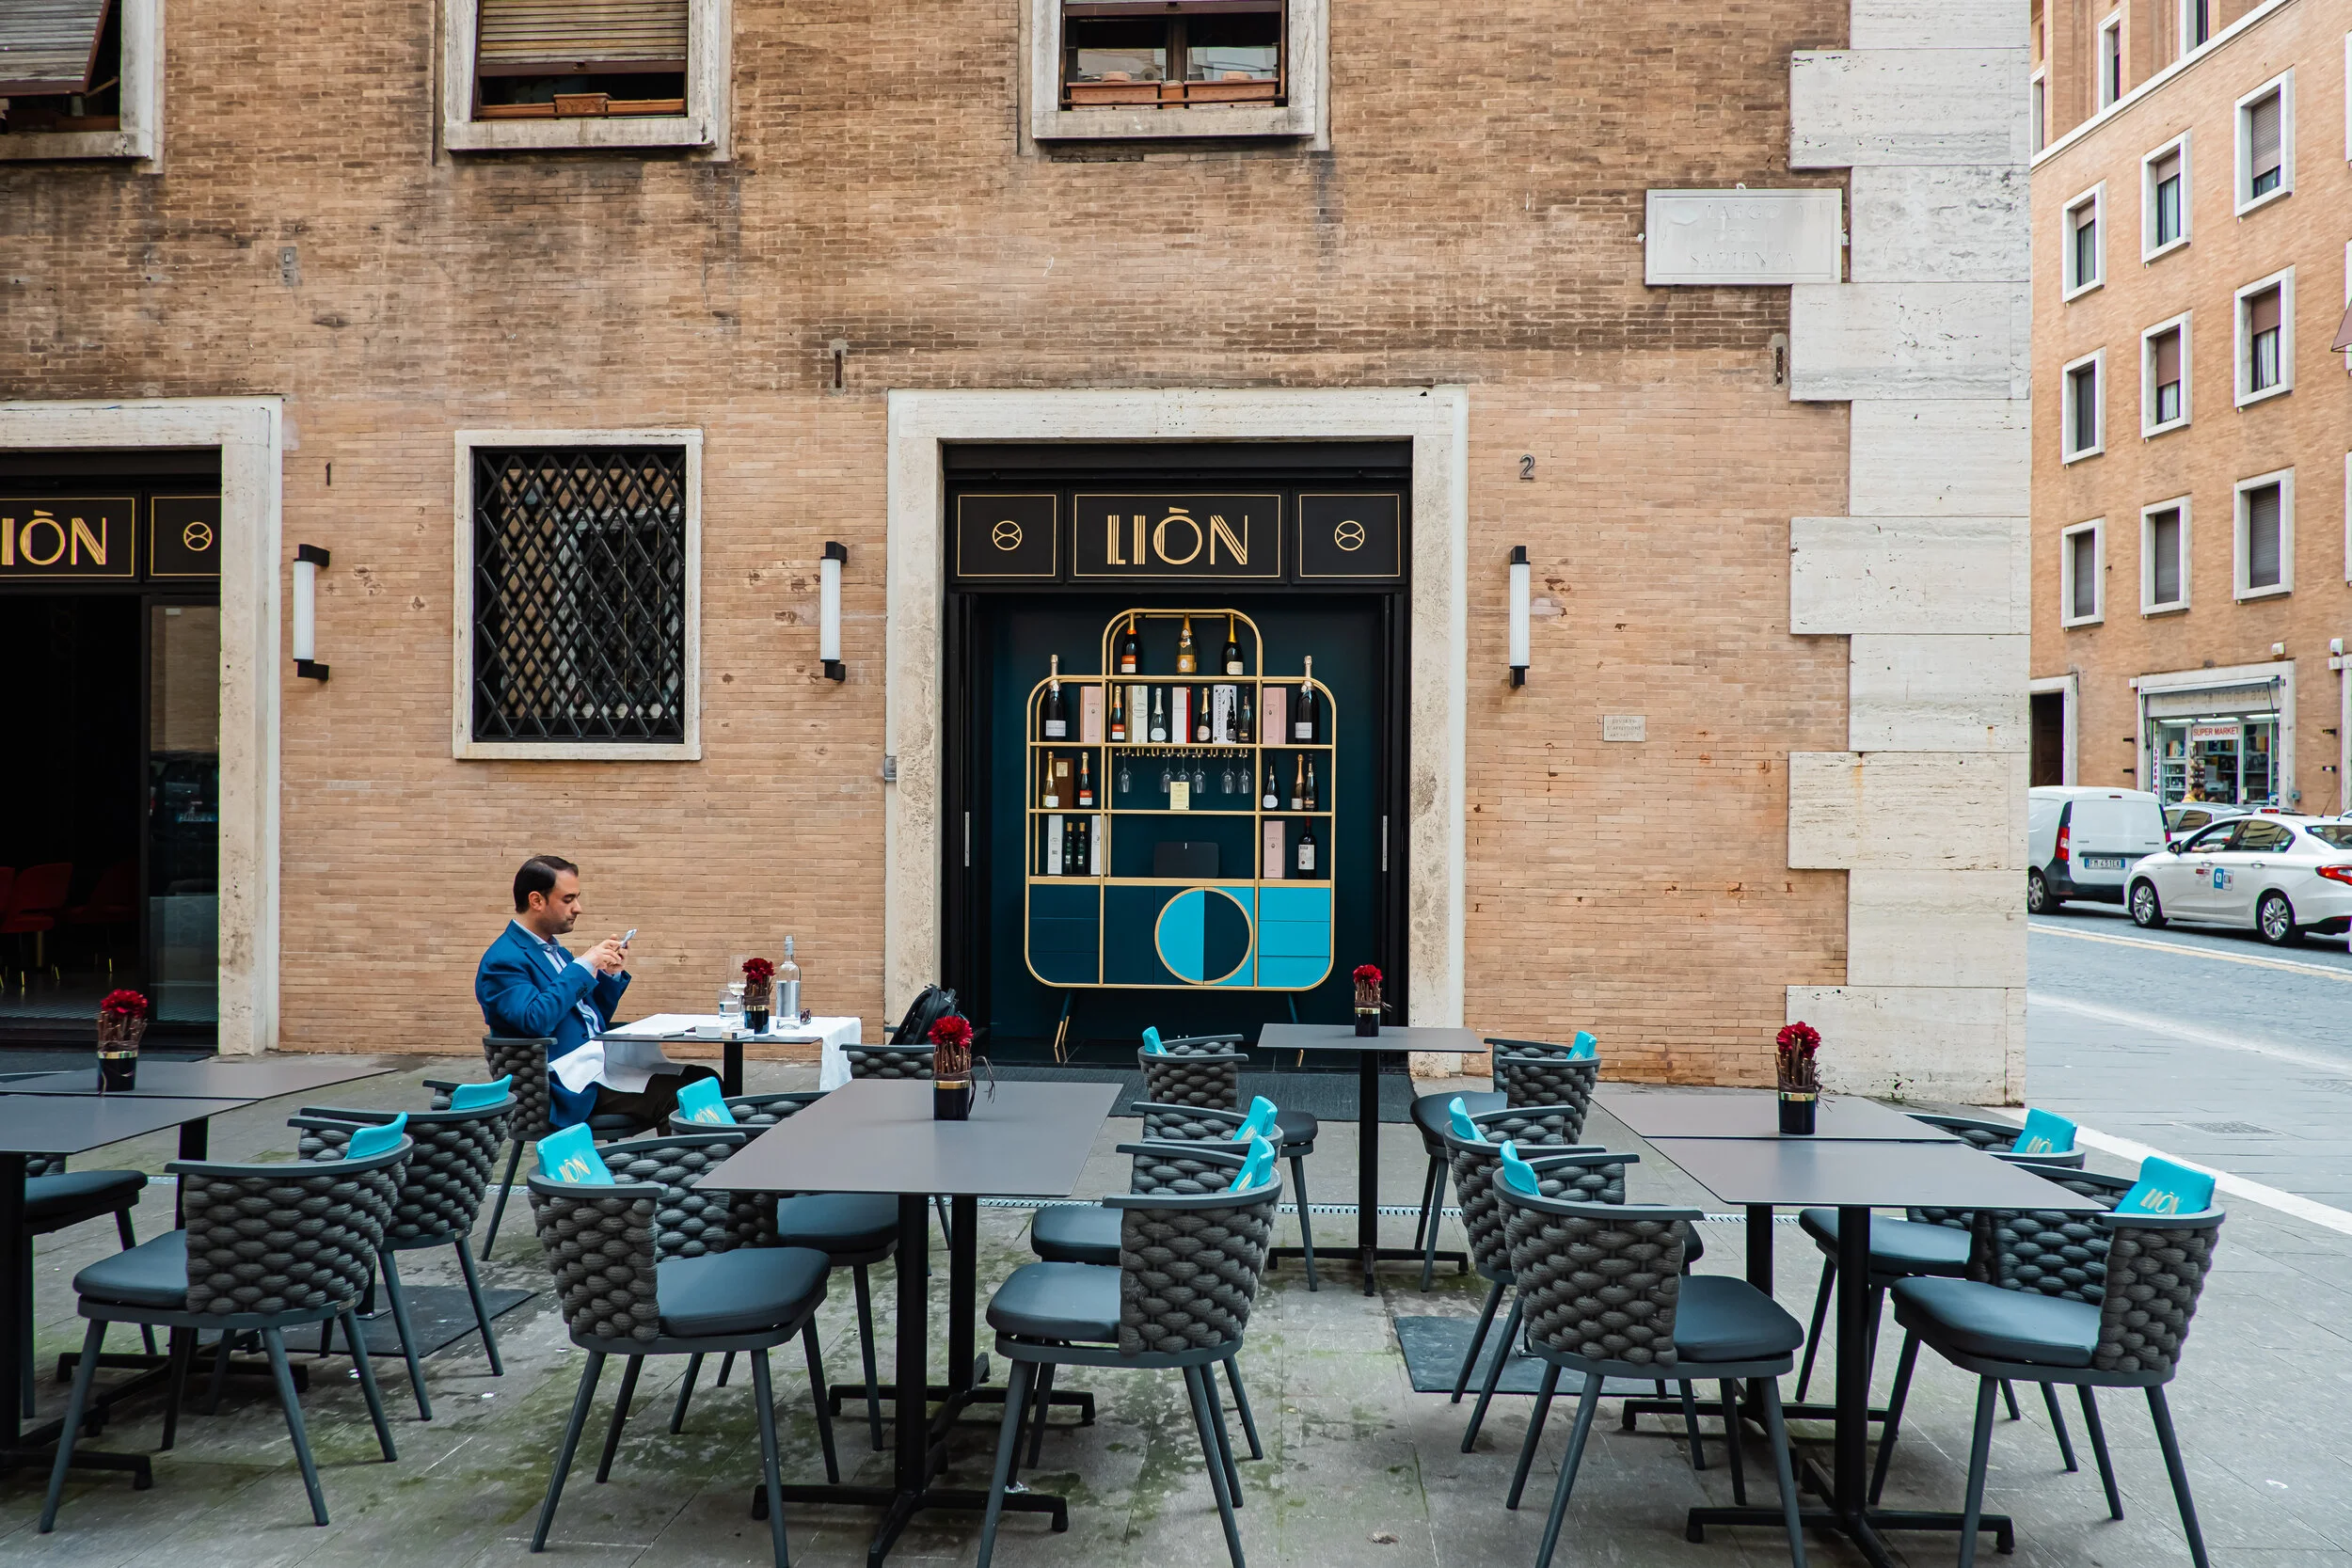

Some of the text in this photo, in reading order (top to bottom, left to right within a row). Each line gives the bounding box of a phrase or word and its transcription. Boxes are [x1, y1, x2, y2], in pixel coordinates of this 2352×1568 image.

[1518, 454, 1535, 480] 2
[1, 509, 107, 565] IÒN
[2193, 726, 2239, 736] SUPER MARKET
